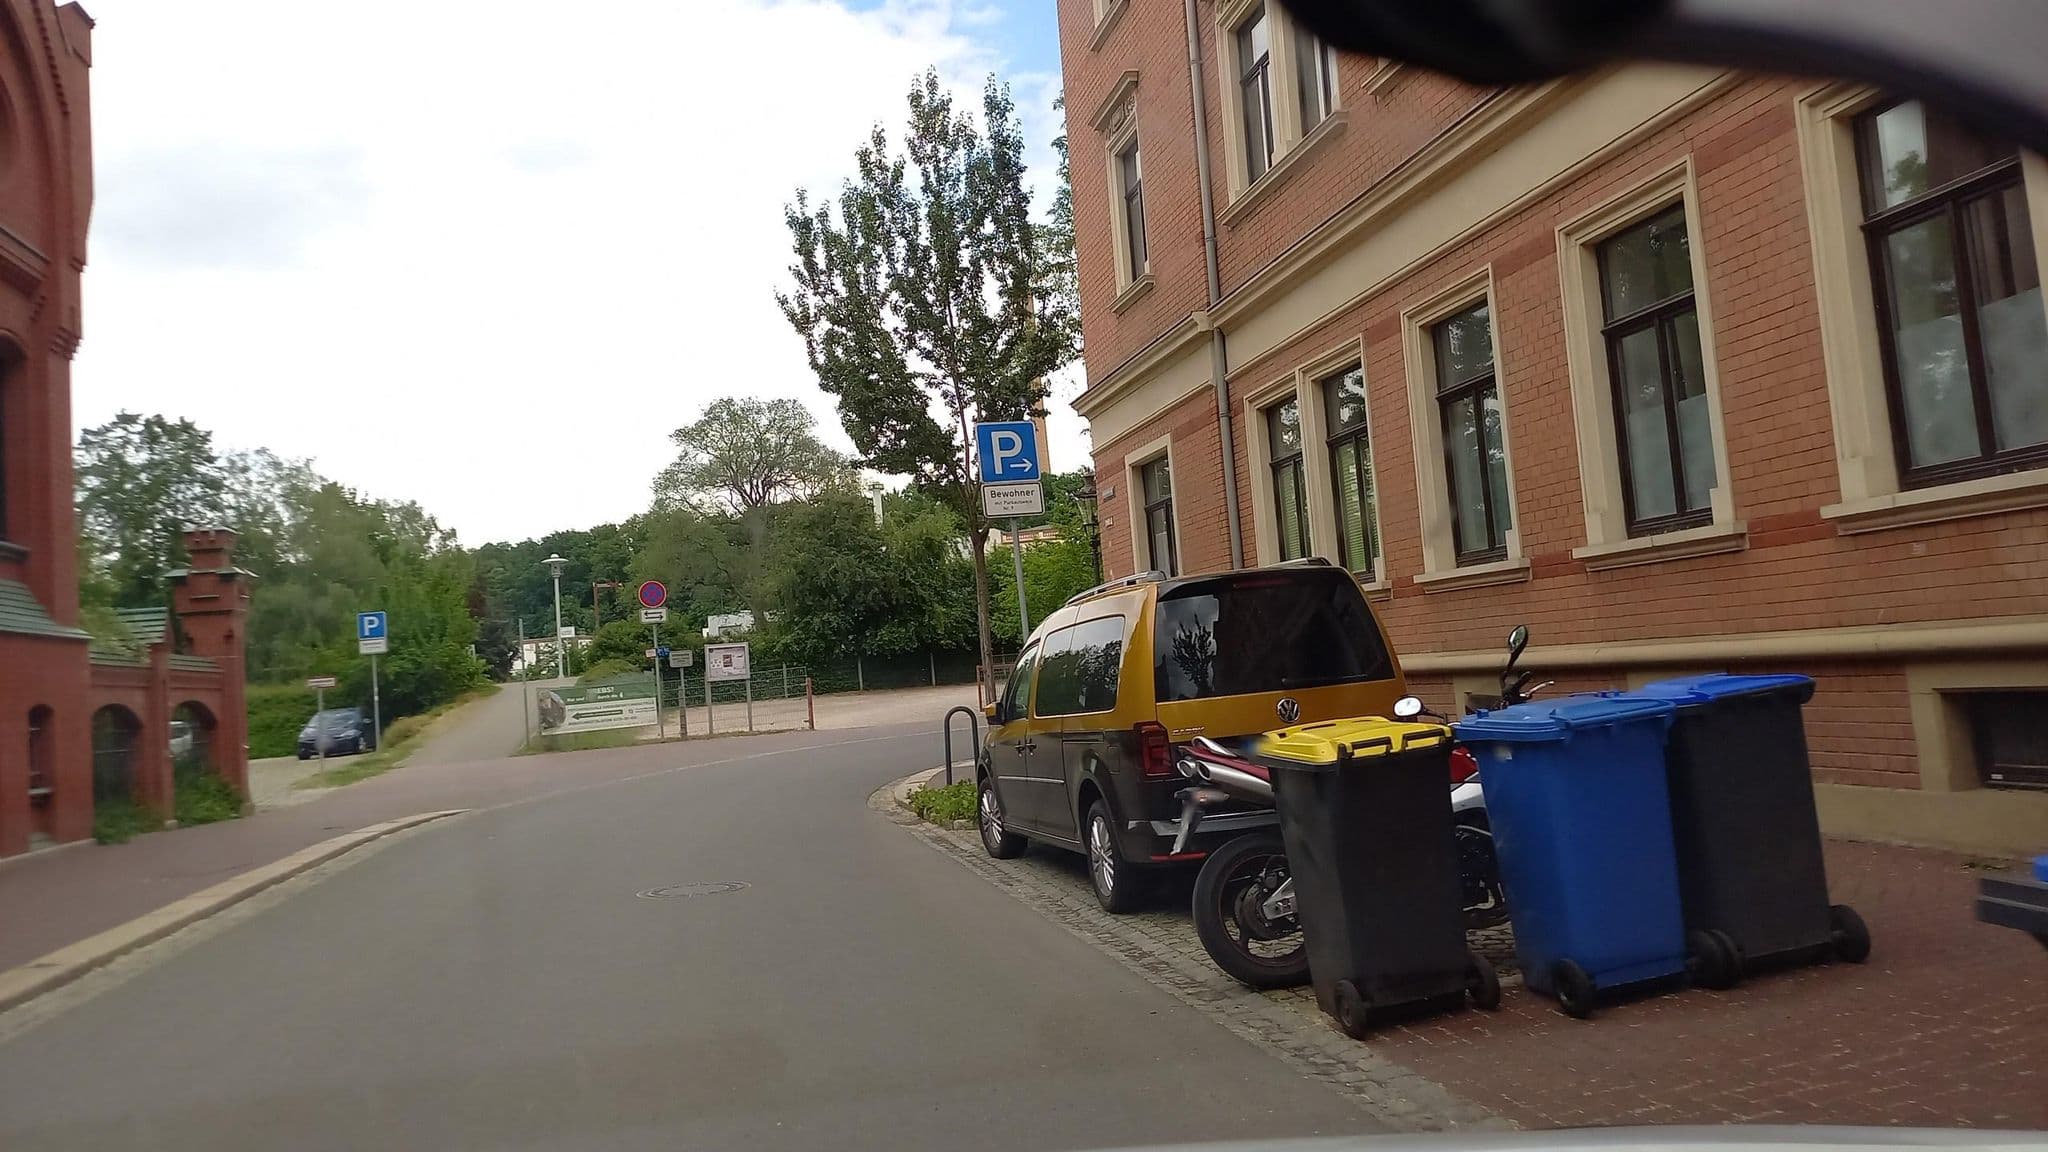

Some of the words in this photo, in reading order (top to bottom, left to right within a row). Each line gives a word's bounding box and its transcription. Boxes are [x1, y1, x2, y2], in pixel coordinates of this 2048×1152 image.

[990, 430, 1023, 475] P
[990, 489, 1035, 499] Bewohner
[363, 616, 380, 636] P
